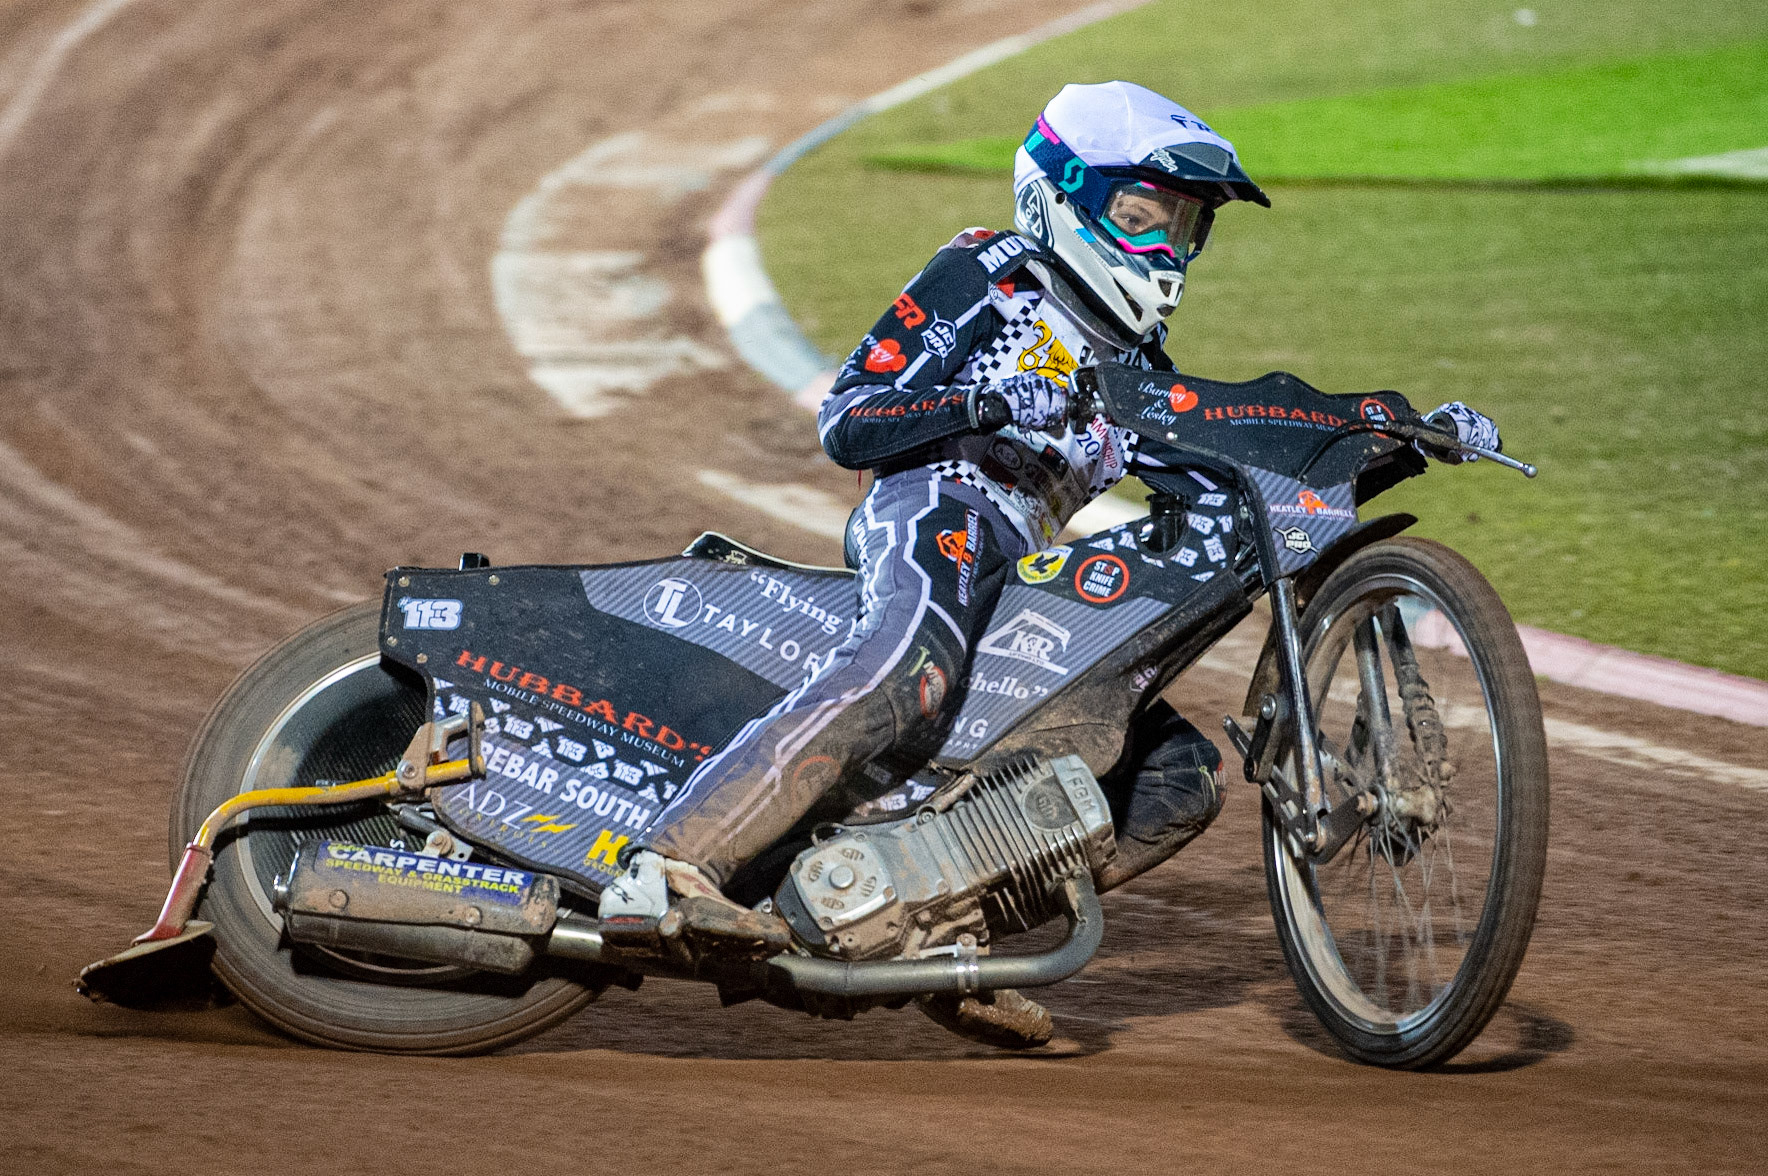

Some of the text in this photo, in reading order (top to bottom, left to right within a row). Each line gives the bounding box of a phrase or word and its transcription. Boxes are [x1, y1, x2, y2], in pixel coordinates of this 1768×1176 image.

[1083, 580, 1112, 597] CRIME
[1089, 570, 1115, 587] KNIFE
[484, 677, 538, 705] MOBILE
[540, 699, 619, 737] SPEEDWAY
[620, 731, 685, 768] MUSEUM
[449, 783, 534, 830] ADZ
[559, 779, 651, 830] SOUTH
[325, 858, 520, 894] SPEEDWAY & GRASSTRACK
[328, 847, 525, 886] CARPENTER
[377, 874, 463, 894] EQUIPMENT
